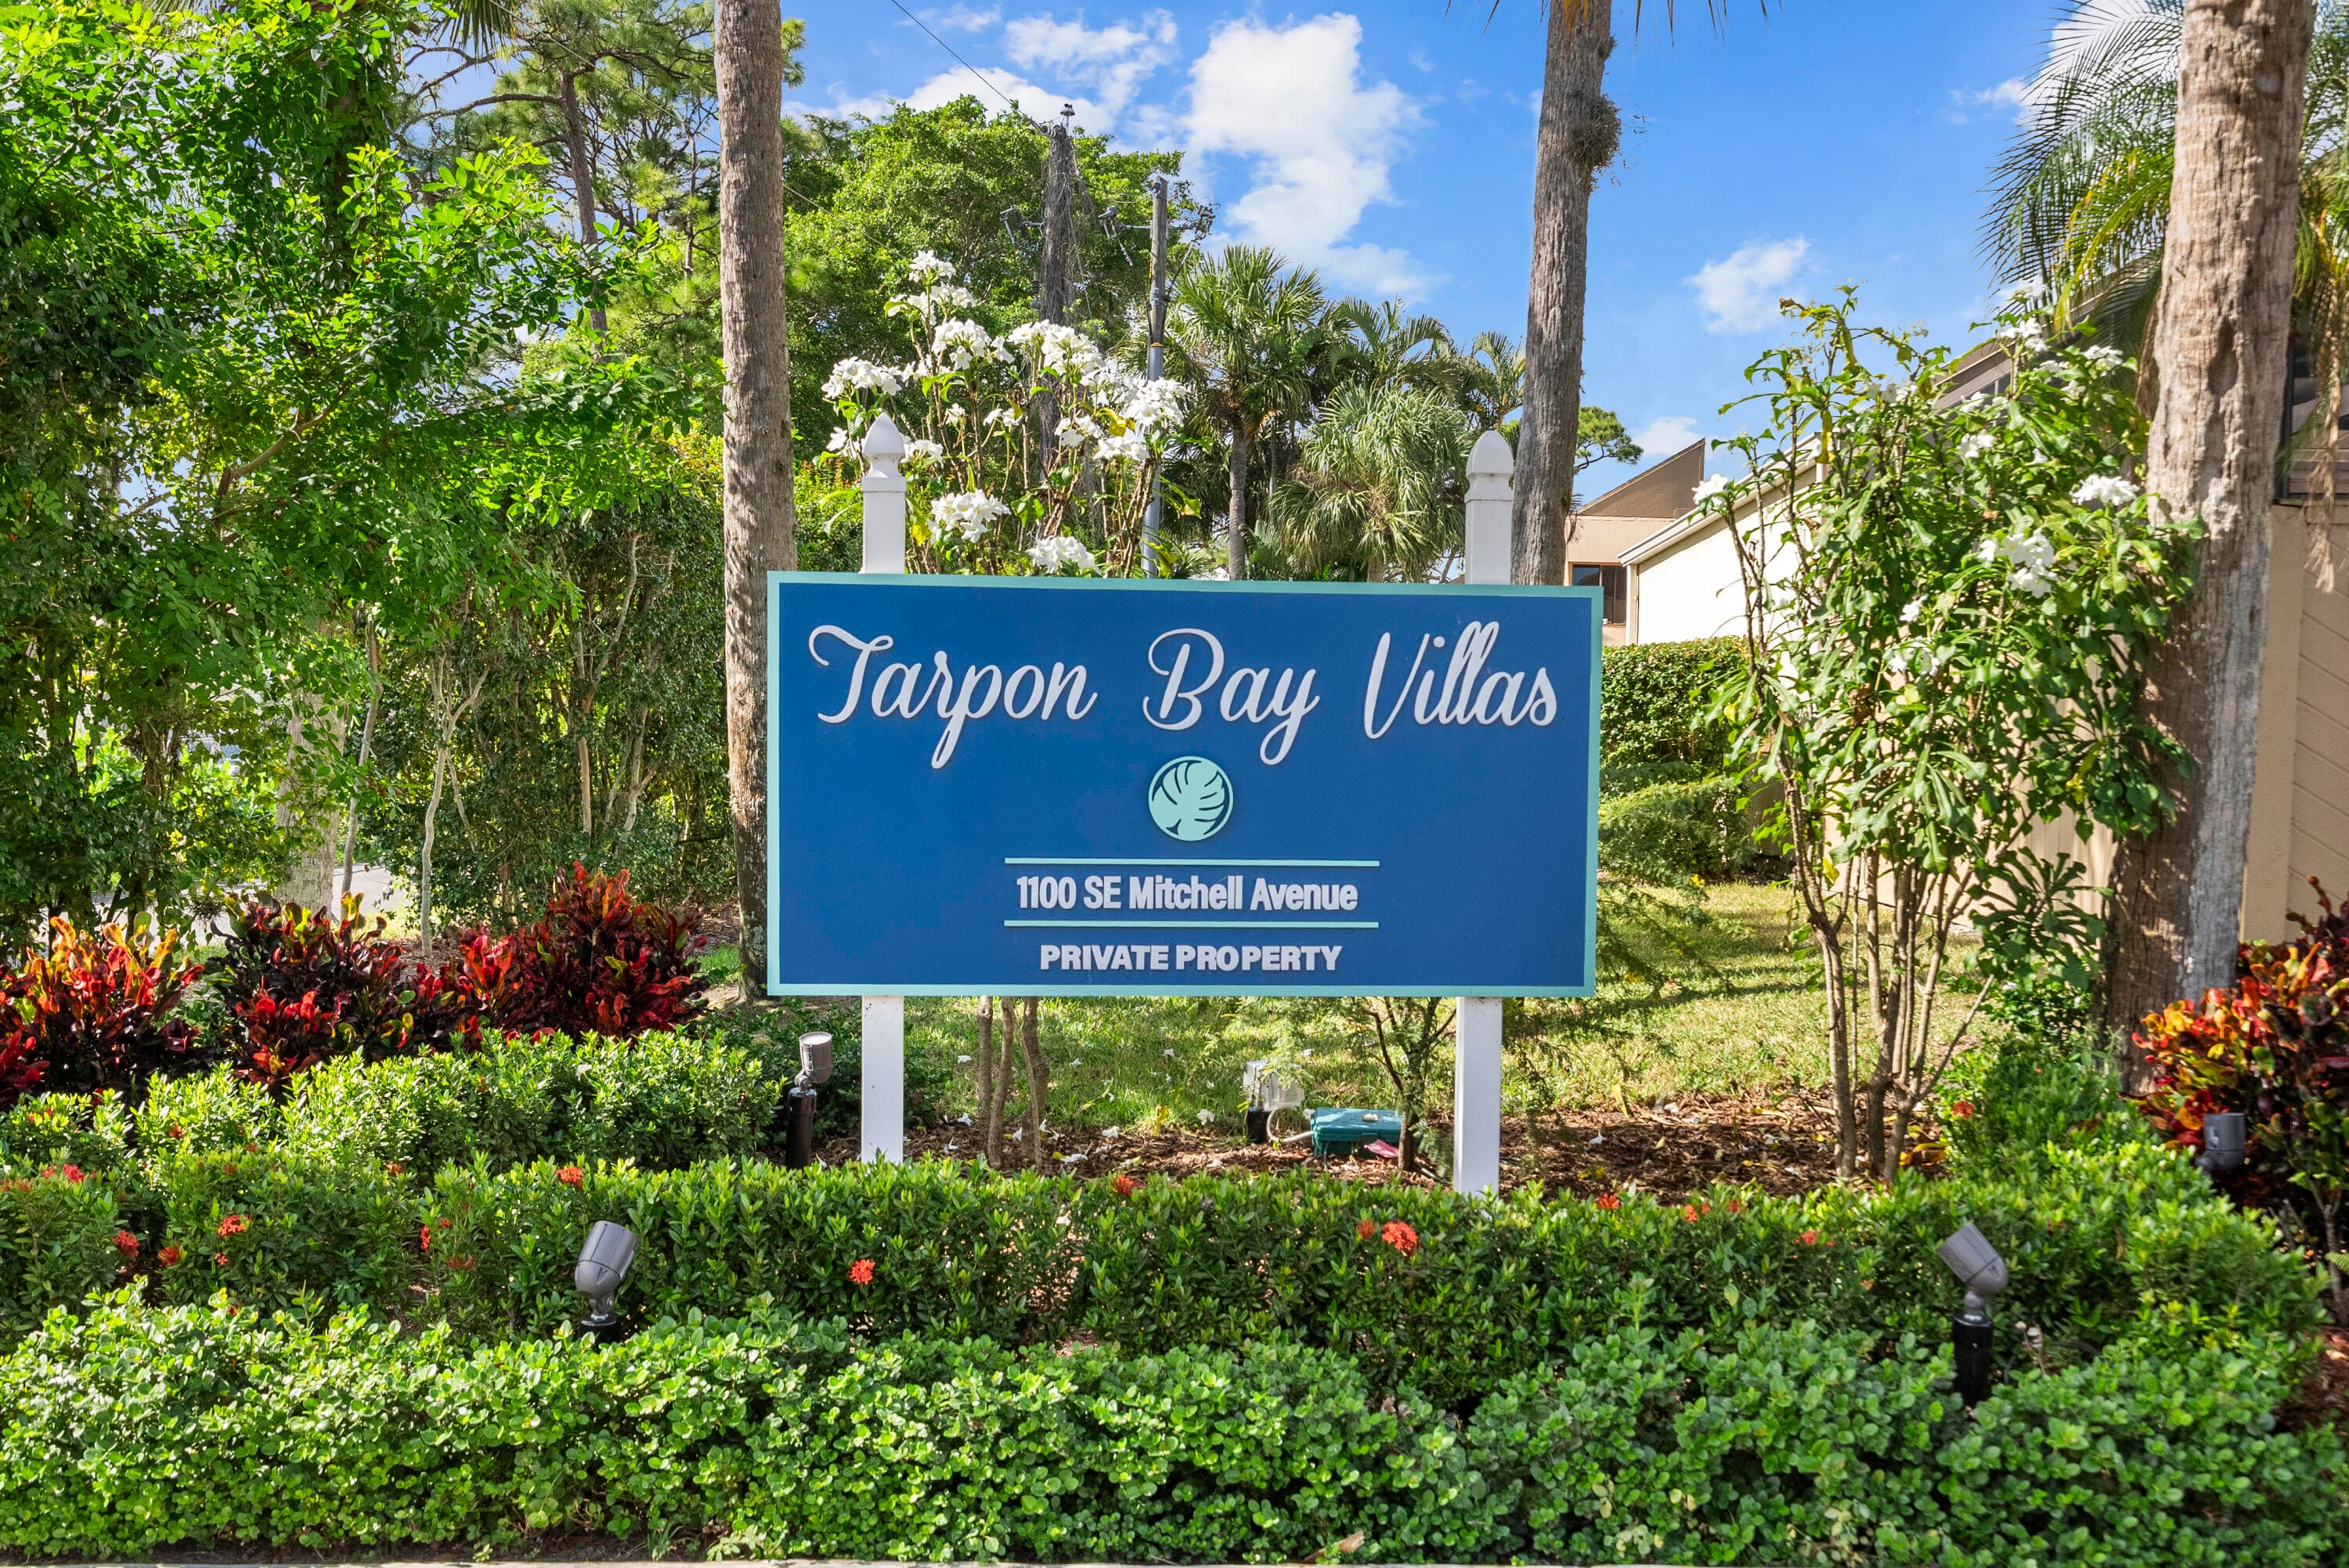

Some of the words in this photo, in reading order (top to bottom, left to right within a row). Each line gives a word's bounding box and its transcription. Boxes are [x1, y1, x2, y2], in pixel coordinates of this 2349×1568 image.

[809, 625, 1097, 769] Tarpon
[1143, 628, 1319, 765] Bay
[1364, 621, 1558, 739] Villas
[1016, 876, 1077, 909] 1100
[1083, 875, 1121, 909] SE
[1129, 874, 1243, 910] Mitchell
[1250, 878, 1358, 910] Avenue
[1040, 945, 1169, 970] PRIVATE
[1176, 946, 1342, 971] PROPERTY
